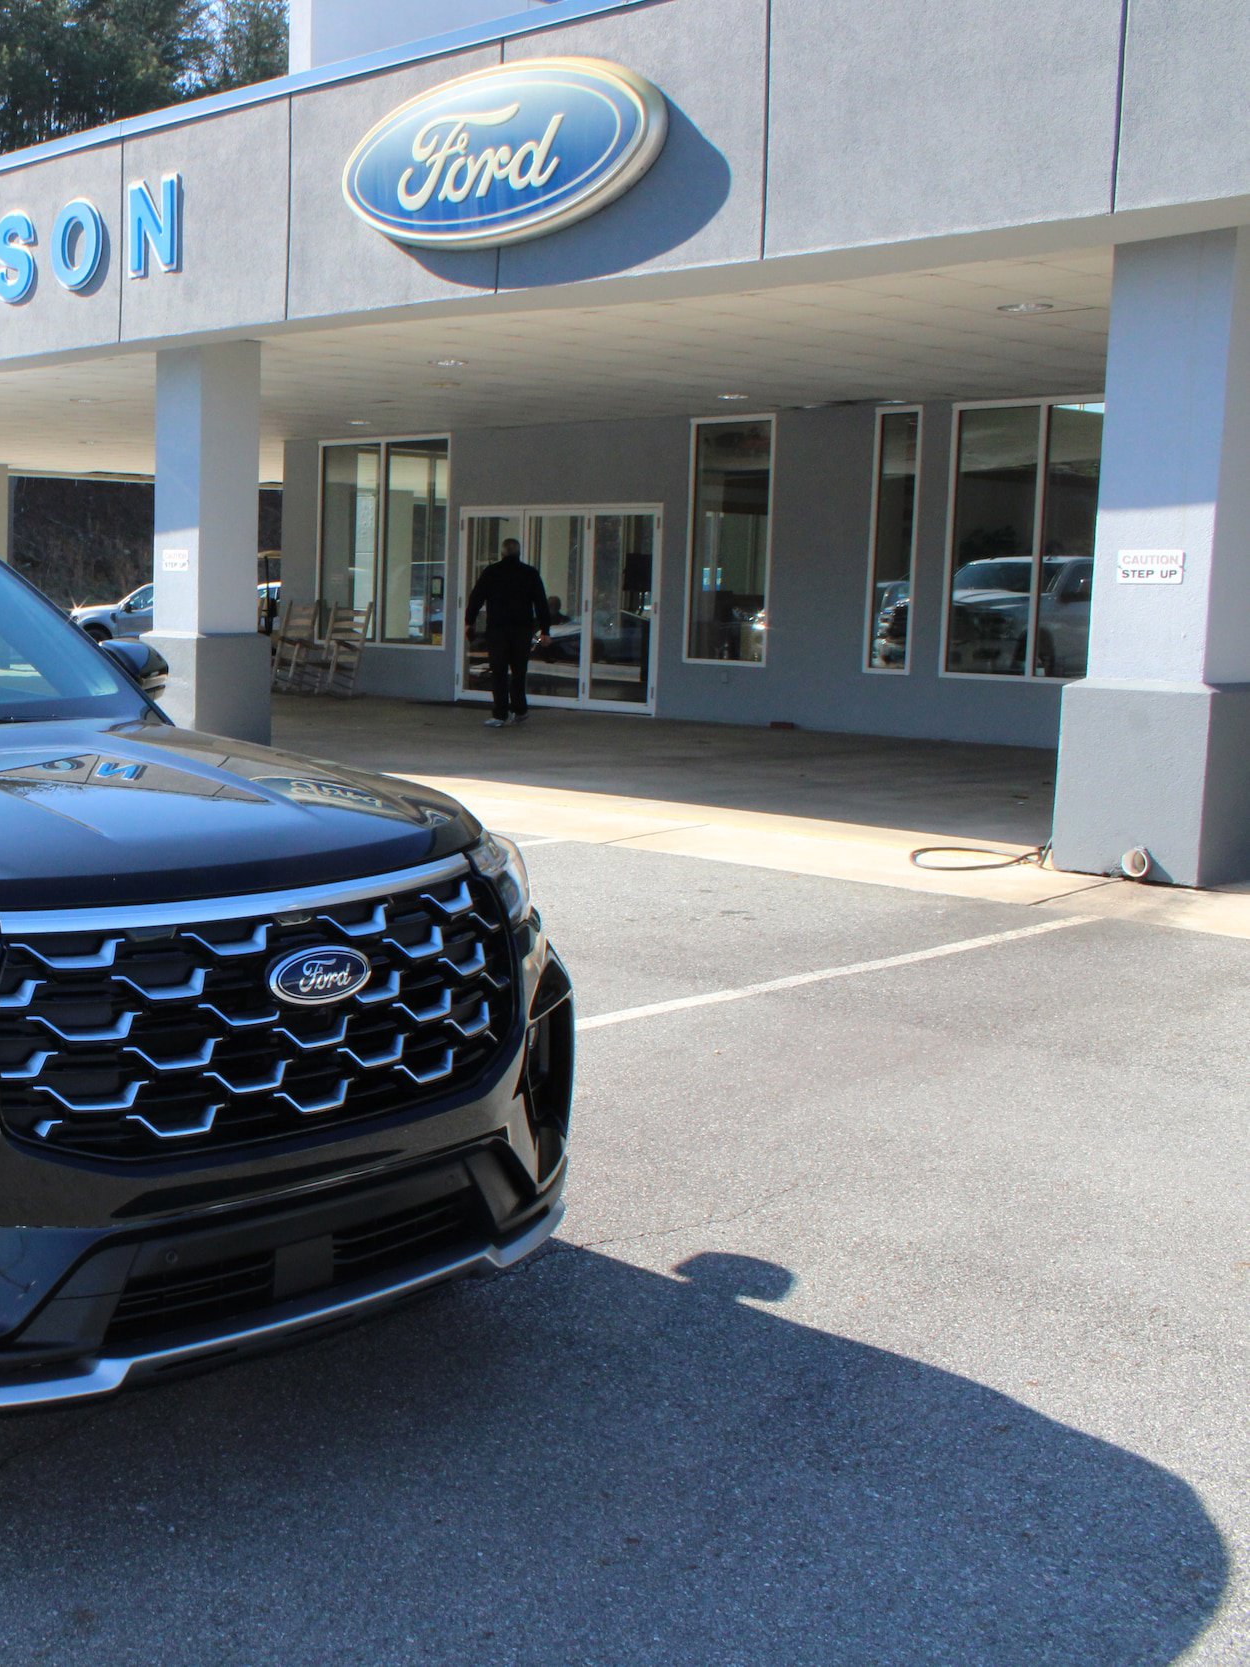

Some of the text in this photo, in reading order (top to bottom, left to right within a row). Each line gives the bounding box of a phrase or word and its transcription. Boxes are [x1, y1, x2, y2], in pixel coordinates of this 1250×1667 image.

[397, 103, 564, 211] Ford
[1122, 555, 1179, 565] CAUTION
[1121, 569, 1178, 579] STEP UP
[299, 958, 351, 992] Ford
